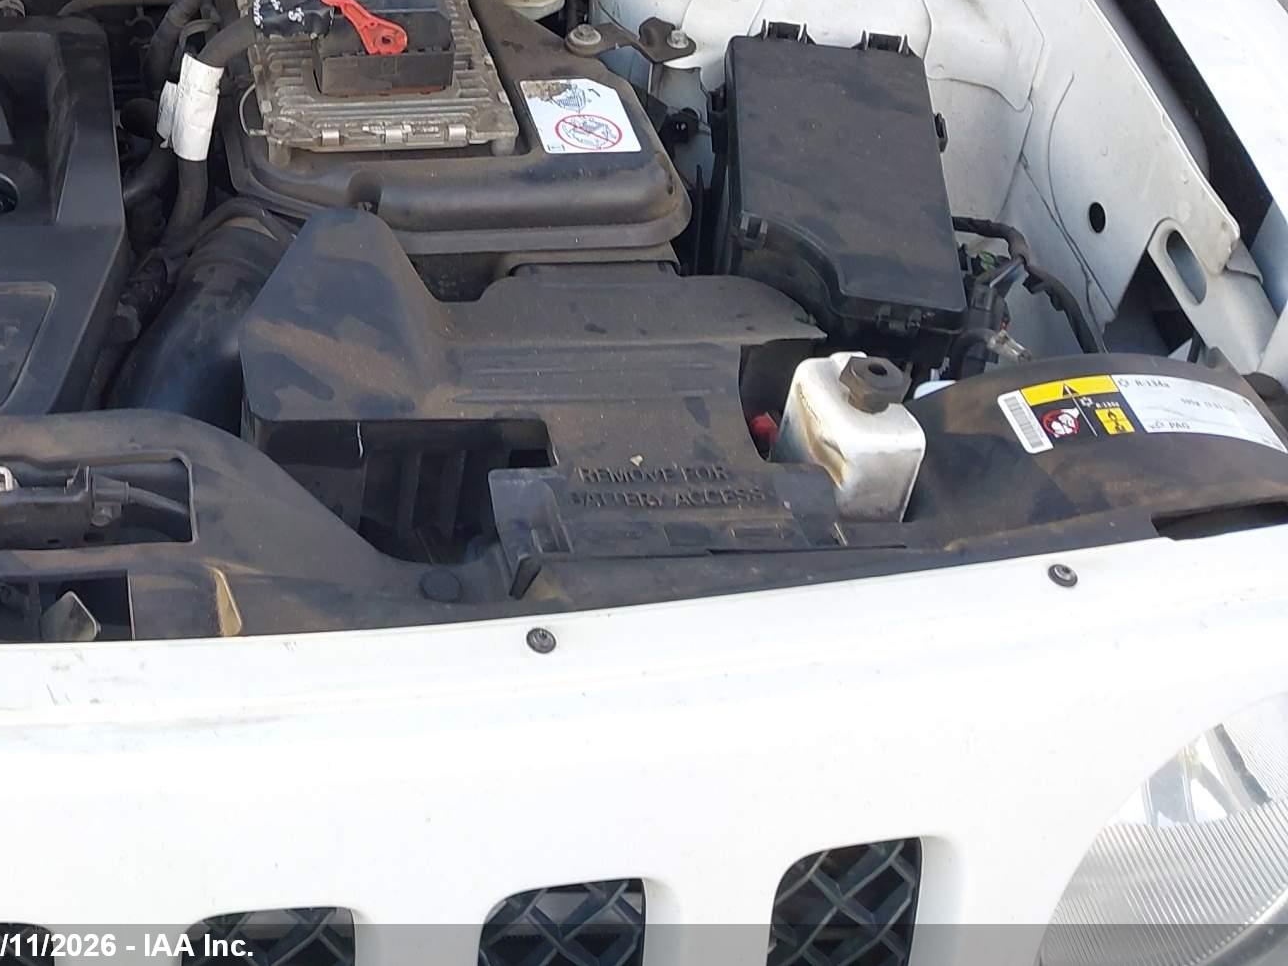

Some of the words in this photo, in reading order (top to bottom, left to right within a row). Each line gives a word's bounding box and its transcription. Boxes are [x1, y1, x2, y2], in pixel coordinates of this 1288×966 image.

[1168, 421, 1191, 430] PAG
[576, 466, 674, 483] REMOVE
[679, 465, 730, 483] FOR
[569, 490, 663, 507] BATTERY
[673, 487, 766, 507] ACCESS
